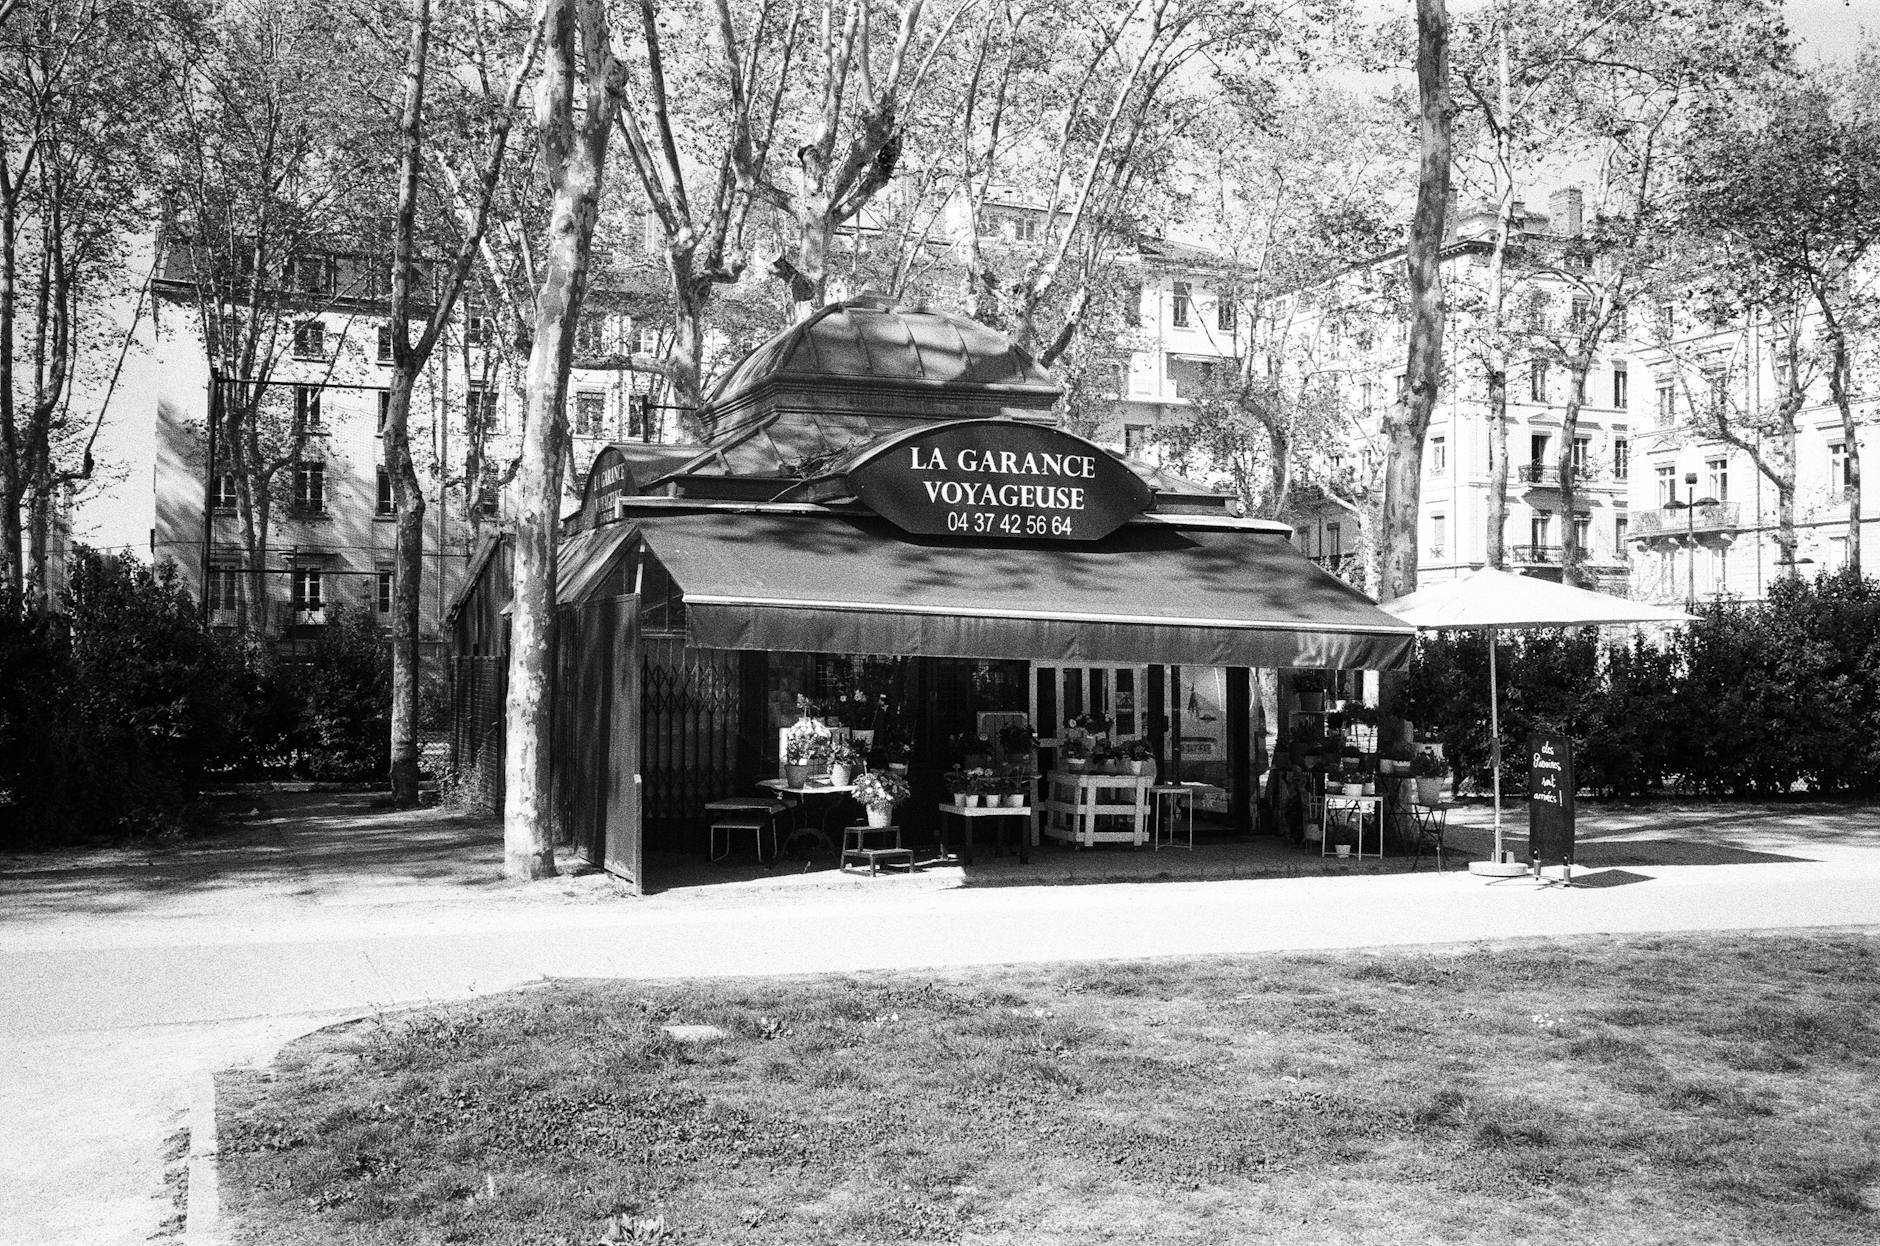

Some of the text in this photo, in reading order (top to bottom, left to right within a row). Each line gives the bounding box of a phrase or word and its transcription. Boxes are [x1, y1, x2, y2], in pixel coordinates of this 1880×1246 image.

[910, 447, 1096, 479] LA GARANCE
[922, 480, 1085, 510] VOYAGEUSE
[947, 511, 1073, 536] 04 37 42 56 64
